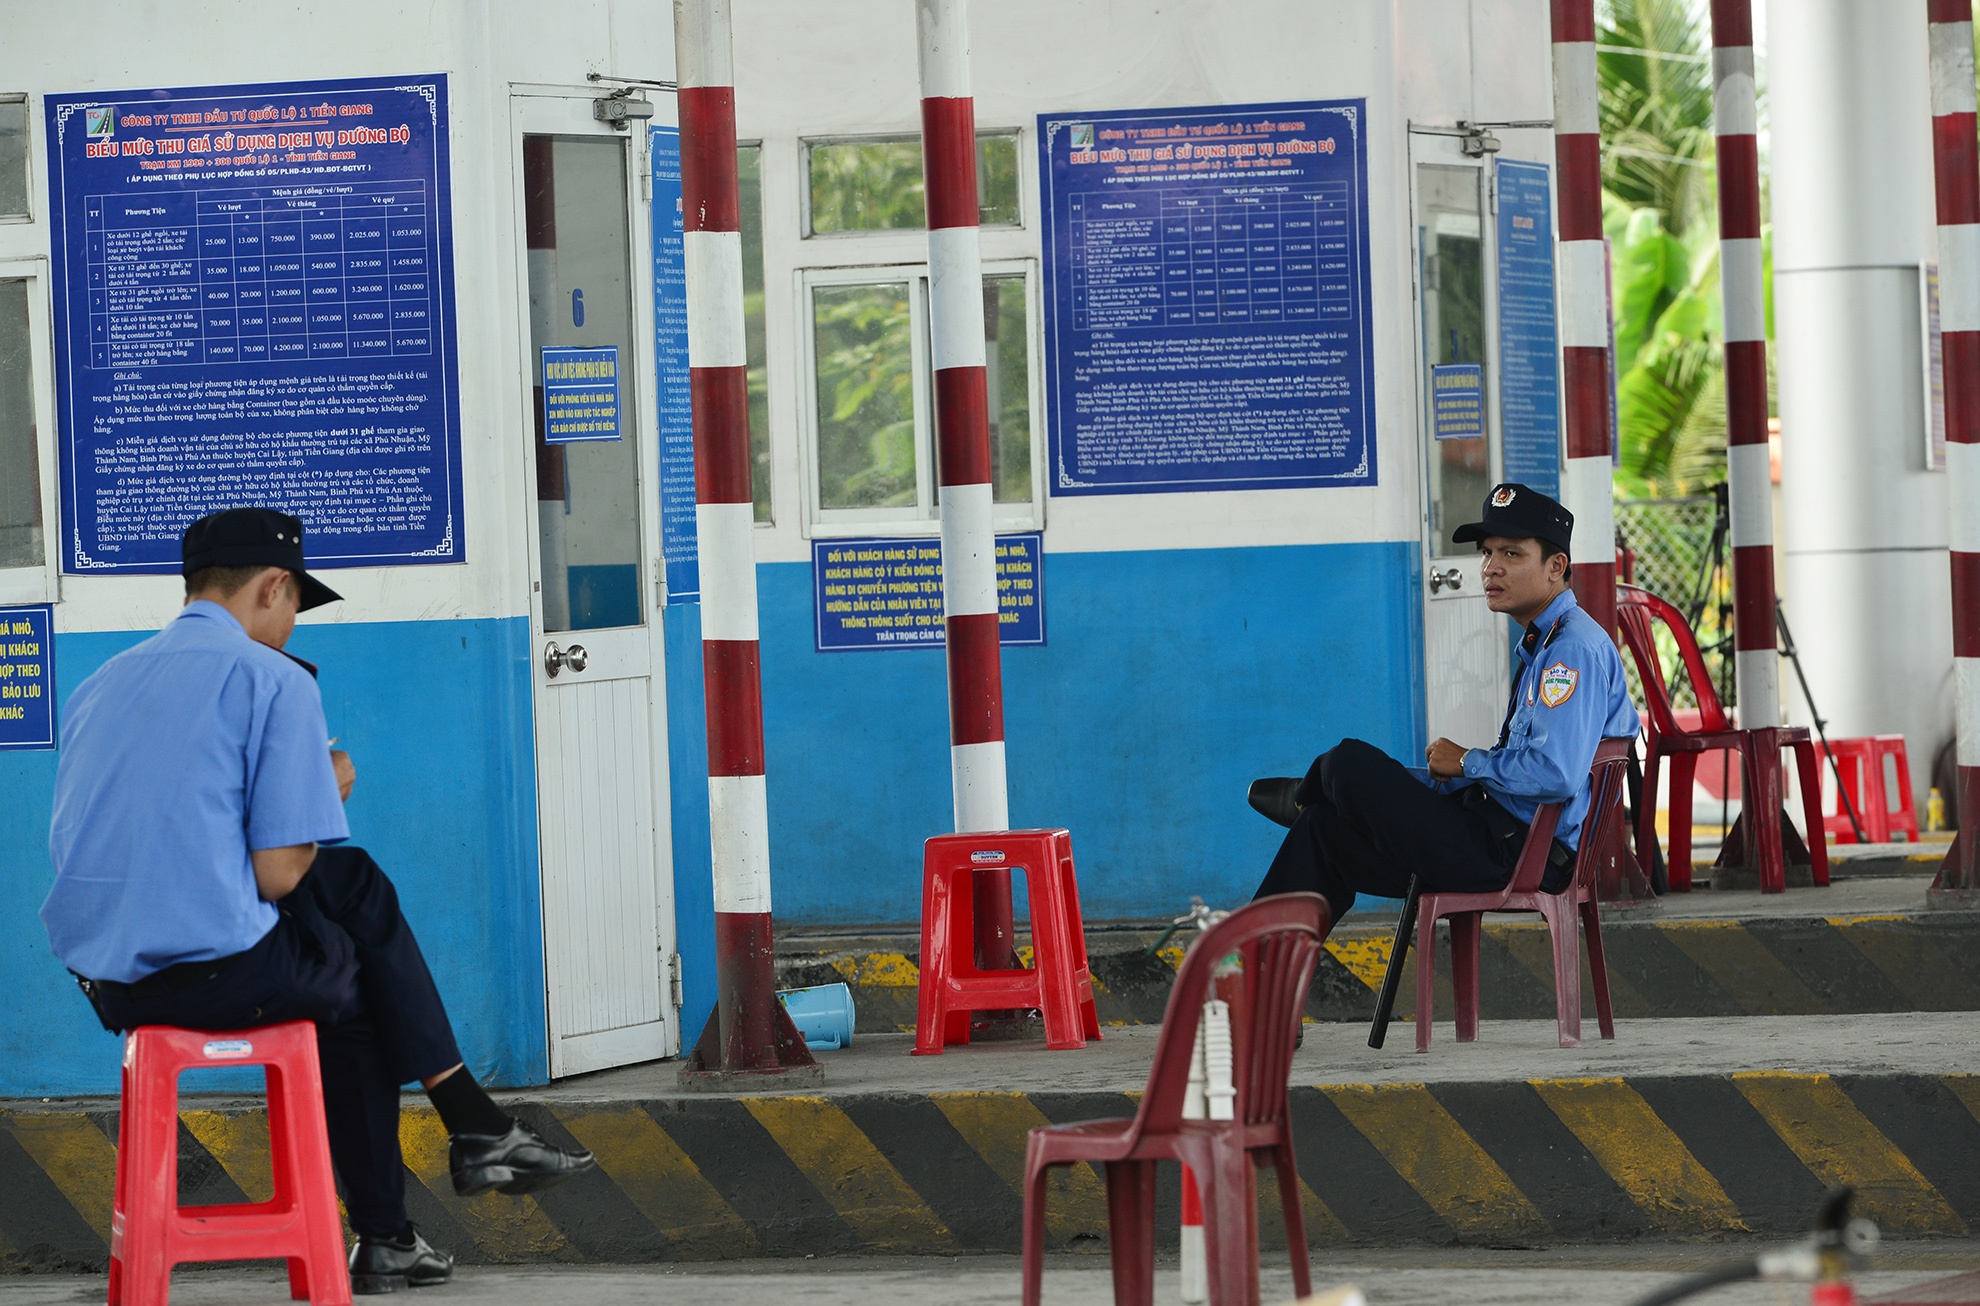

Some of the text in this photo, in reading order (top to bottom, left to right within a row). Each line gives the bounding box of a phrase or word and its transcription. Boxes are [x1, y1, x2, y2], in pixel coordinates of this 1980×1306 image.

[121, 113, 152, 127] CÔNG
[153, 114, 169, 125] TY
[170, 112, 202, 124] TNHH
[229, 108, 247, 121] TƯ
[248, 105, 279, 122] QUỐC
[281, 105, 297, 120] LỘ
[300, 107, 307, 118] 1
[338, 103, 373, 116] GIANG
[86, 123, 410, 158] BIỂU MỨC THU GIÁ SỬ DỤNG DỊCH VỤ ĐƯỜNG BỘ
[139, 160, 165, 170] TRẠM
[167, 159, 181, 168] KM
[214, 157, 231, 166] 300
[232, 153, 256, 166] QUỐC
[258, 153, 270, 165] LỘ
[272, 154, 278, 163] 1
[284, 151, 306, 162] TỈNH
[329, 150, 356, 160] GIANG
[143, 174, 162, 182] DỤNG
[217, 170, 232, 178] HỢP
[234, 168, 254, 177] ĐỒNG
[255, 167, 266, 176] SỐ
[349, 230, 380, 238] 2.025.000
[392, 228, 421, 236] 1.053.000
[572, 288, 584, 327] 6
[396, 338, 426, 346] 5.670.000
[1451, 329, 1459, 359] 5
[828, 549, 841, 562] ĐỐI
[842, 549, 856, 561] VỚI
[857, 548, 883, 561] KHÁCH
[884, 548, 905, 560] HÀNG
[906, 546, 917, 559] SỬ
[918, 548, 939, 560] DỤNG
[1009, 542, 1028, 557] NHỎ,
[825, 560, 1031, 579] KHÁCH HÀNG CÓ Ý KIẾN ĐÓNG KHÁCH
[825, 578, 1033, 595] HÀNG DI CHUYỂN PHƯƠNG TIỆN THEO
[826, 592, 1033, 612] HƯỚNG DẪN CỦA NHÂN VIÊN TẠI BẢO LƯU
[12, 617, 34, 636] NHỎ,
[840, 610, 1019, 628] THÔNG THÔNG SUỐT CHO KHÁC
[876, 628, 944, 641] TRÂN TRỌNG CẢM ƠN
[9, 640, 39, 656] KHÁCH
[16, 664, 40, 677] THEO
[2, 681, 41, 698] BẢO LƯU
[0, 704, 24, 719] KHÁC
